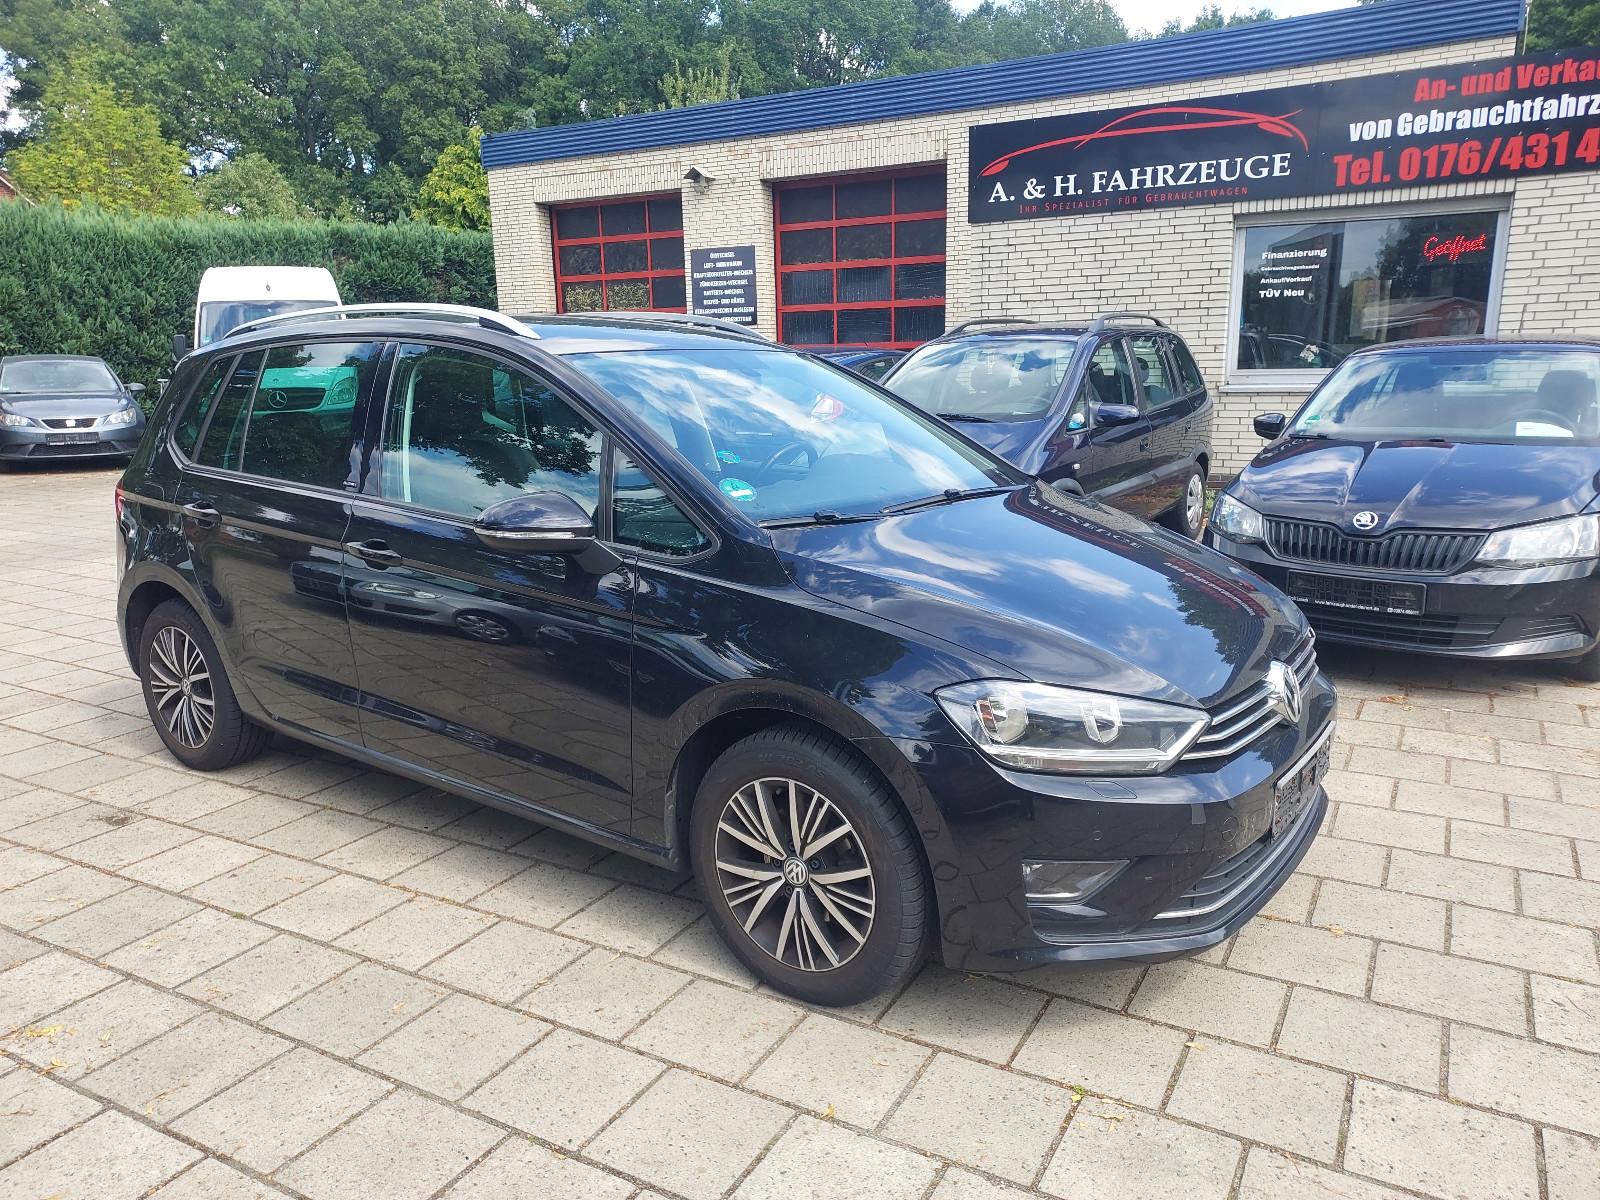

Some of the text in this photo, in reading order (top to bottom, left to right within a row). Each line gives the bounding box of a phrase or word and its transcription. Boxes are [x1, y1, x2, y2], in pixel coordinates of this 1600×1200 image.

[1414, 77, 1456, 103] An-
[1460, 65, 1512, 97] und
[1349, 119, 1392, 142] von
[1333, 151, 1391, 187] Tel.
[1399, 130, 1570, 181] 0176/431
[988, 152, 1291, 203] A. & H. FAHRZEUGE
[1262, 248, 1327, 260] Finanzierung
[1259, 289, 1305, 298] TÜV Neu
